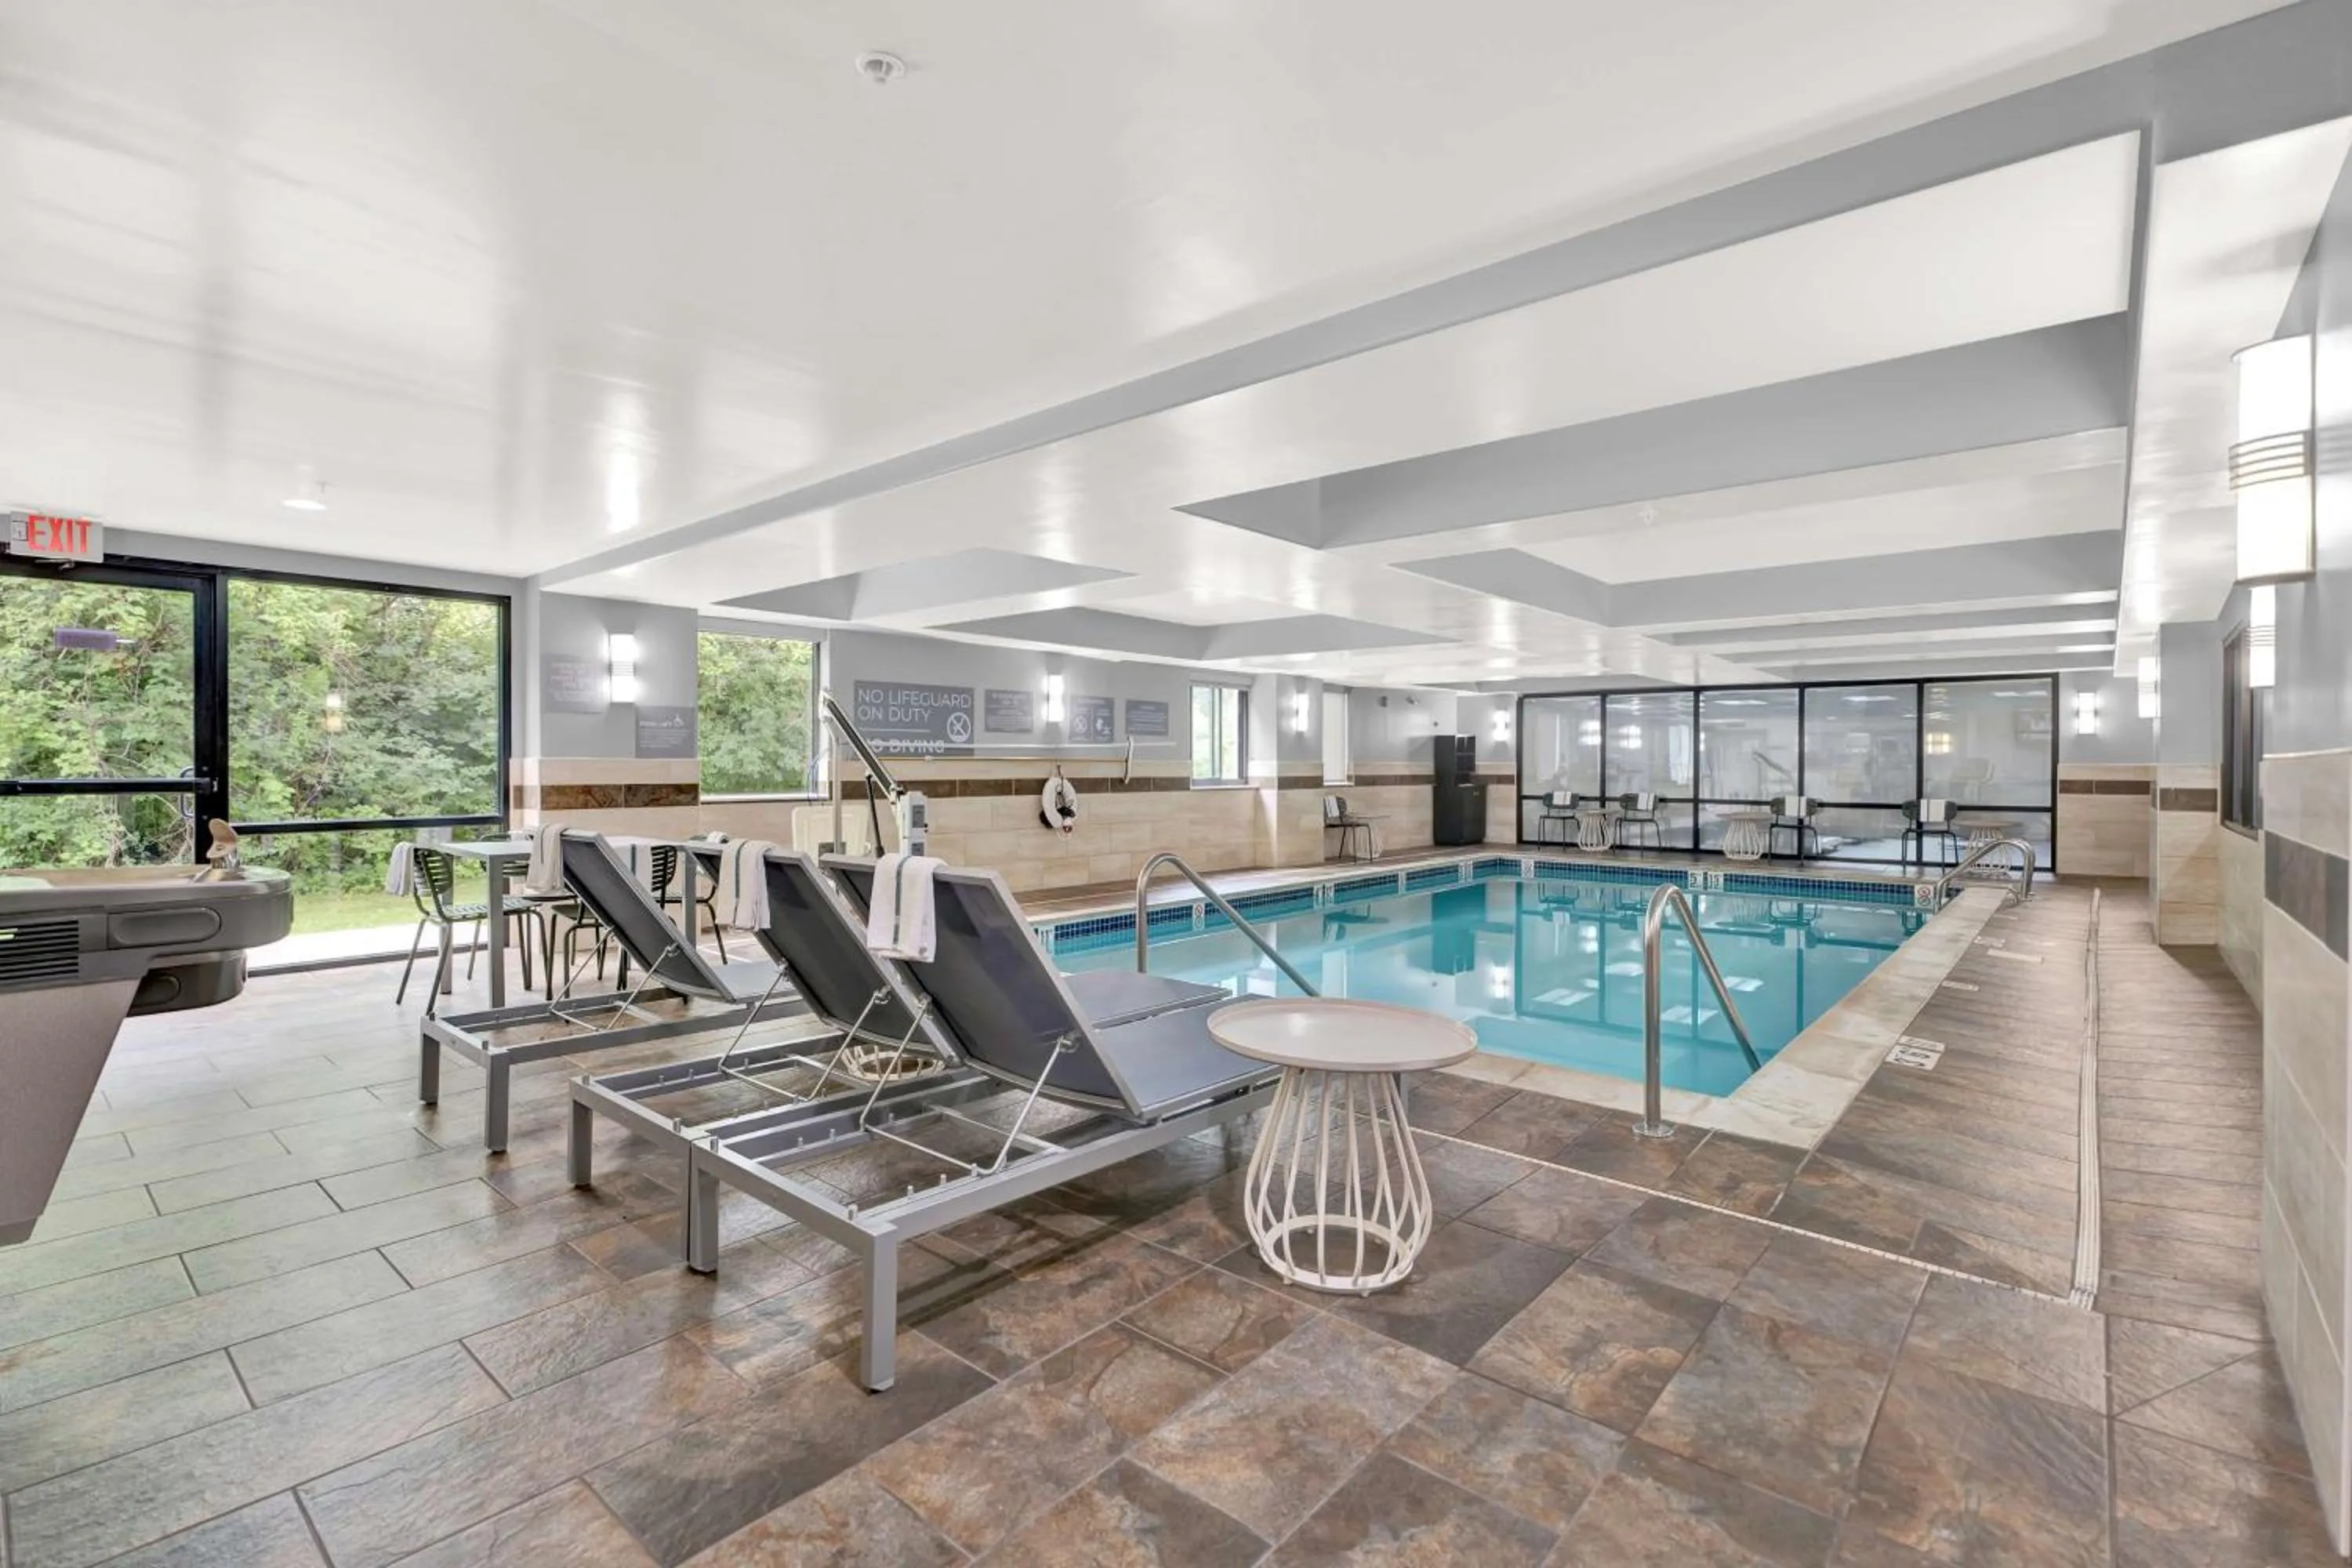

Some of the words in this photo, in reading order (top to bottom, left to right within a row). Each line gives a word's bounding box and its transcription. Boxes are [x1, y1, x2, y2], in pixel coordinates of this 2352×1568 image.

[28, 514, 92, 553] EXIT
[858, 688, 884, 703] NO
[888, 690, 971, 708] LIFEGUARD
[858, 705, 883, 720] ON
[888, 708, 931, 722] DUTY
[890, 739, 944, 753] DIVING
